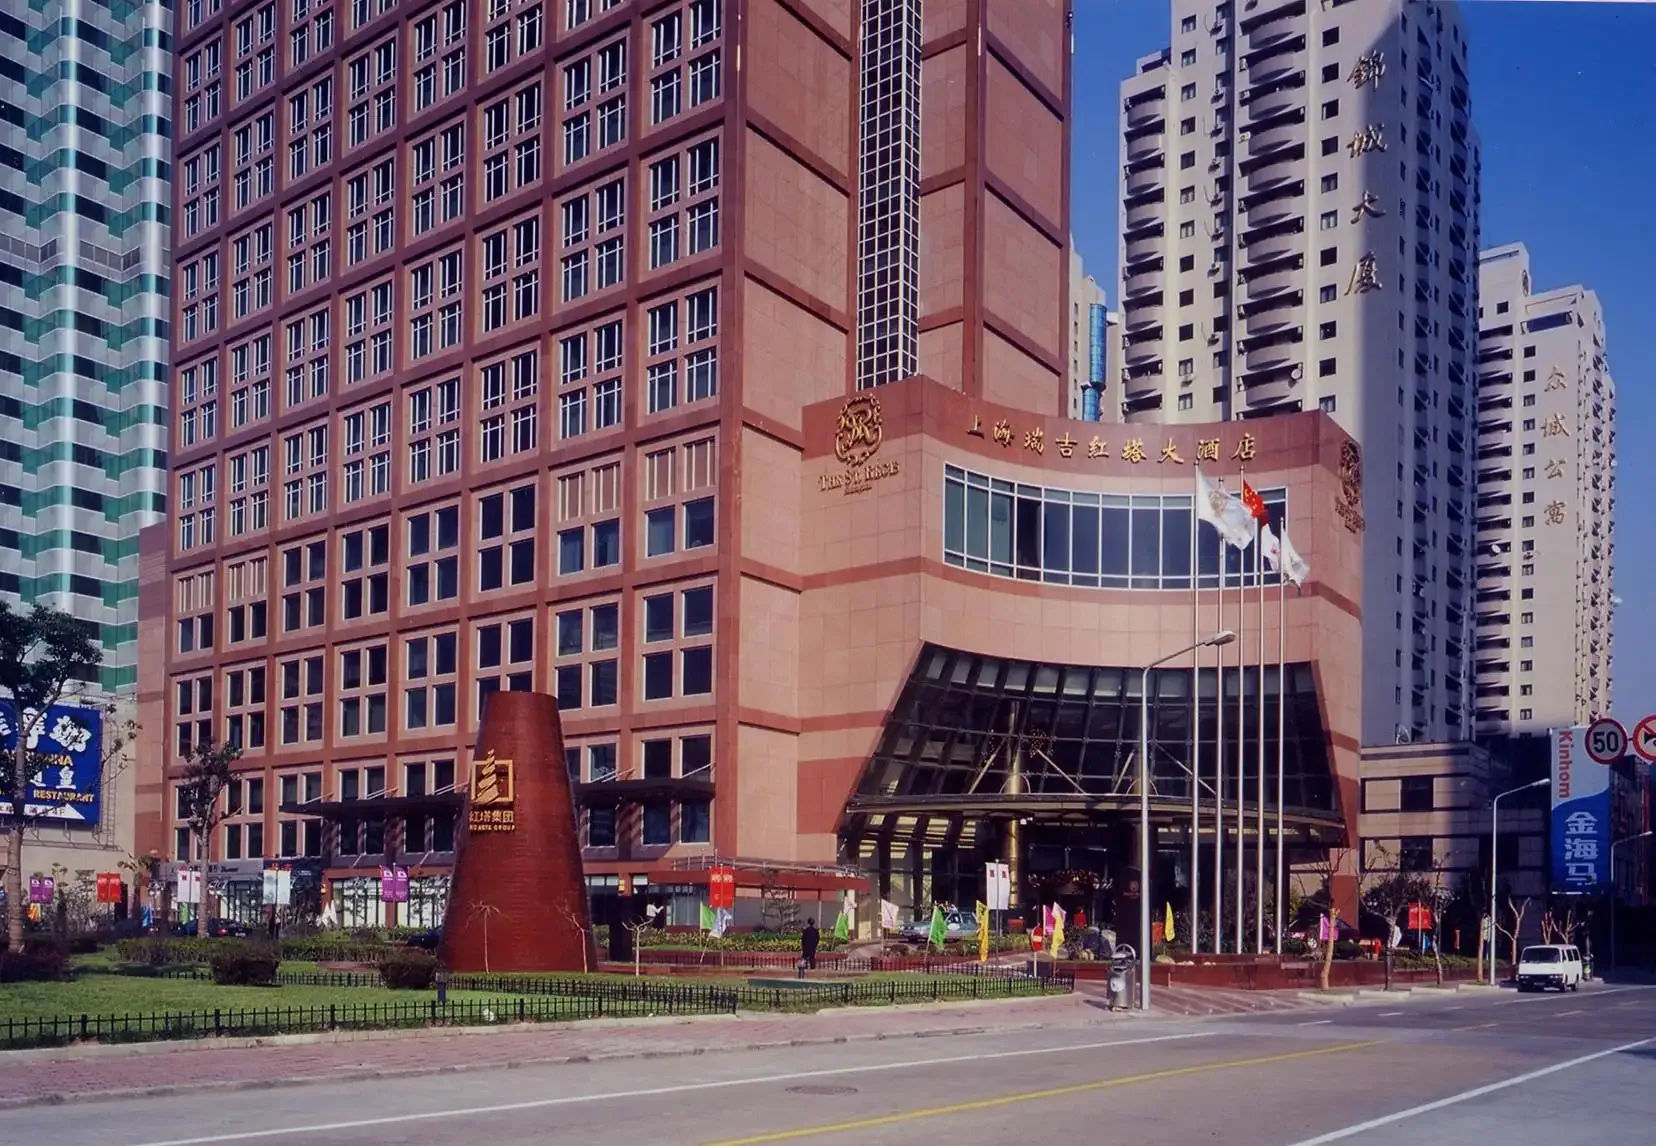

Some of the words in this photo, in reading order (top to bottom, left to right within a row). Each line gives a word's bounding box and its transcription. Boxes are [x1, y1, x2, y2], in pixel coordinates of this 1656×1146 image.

[1593, 731, 1619, 753] 50
[1558, 731, 1574, 799] Kinhom
[33, 788, 94, 802] RESTAURANT
